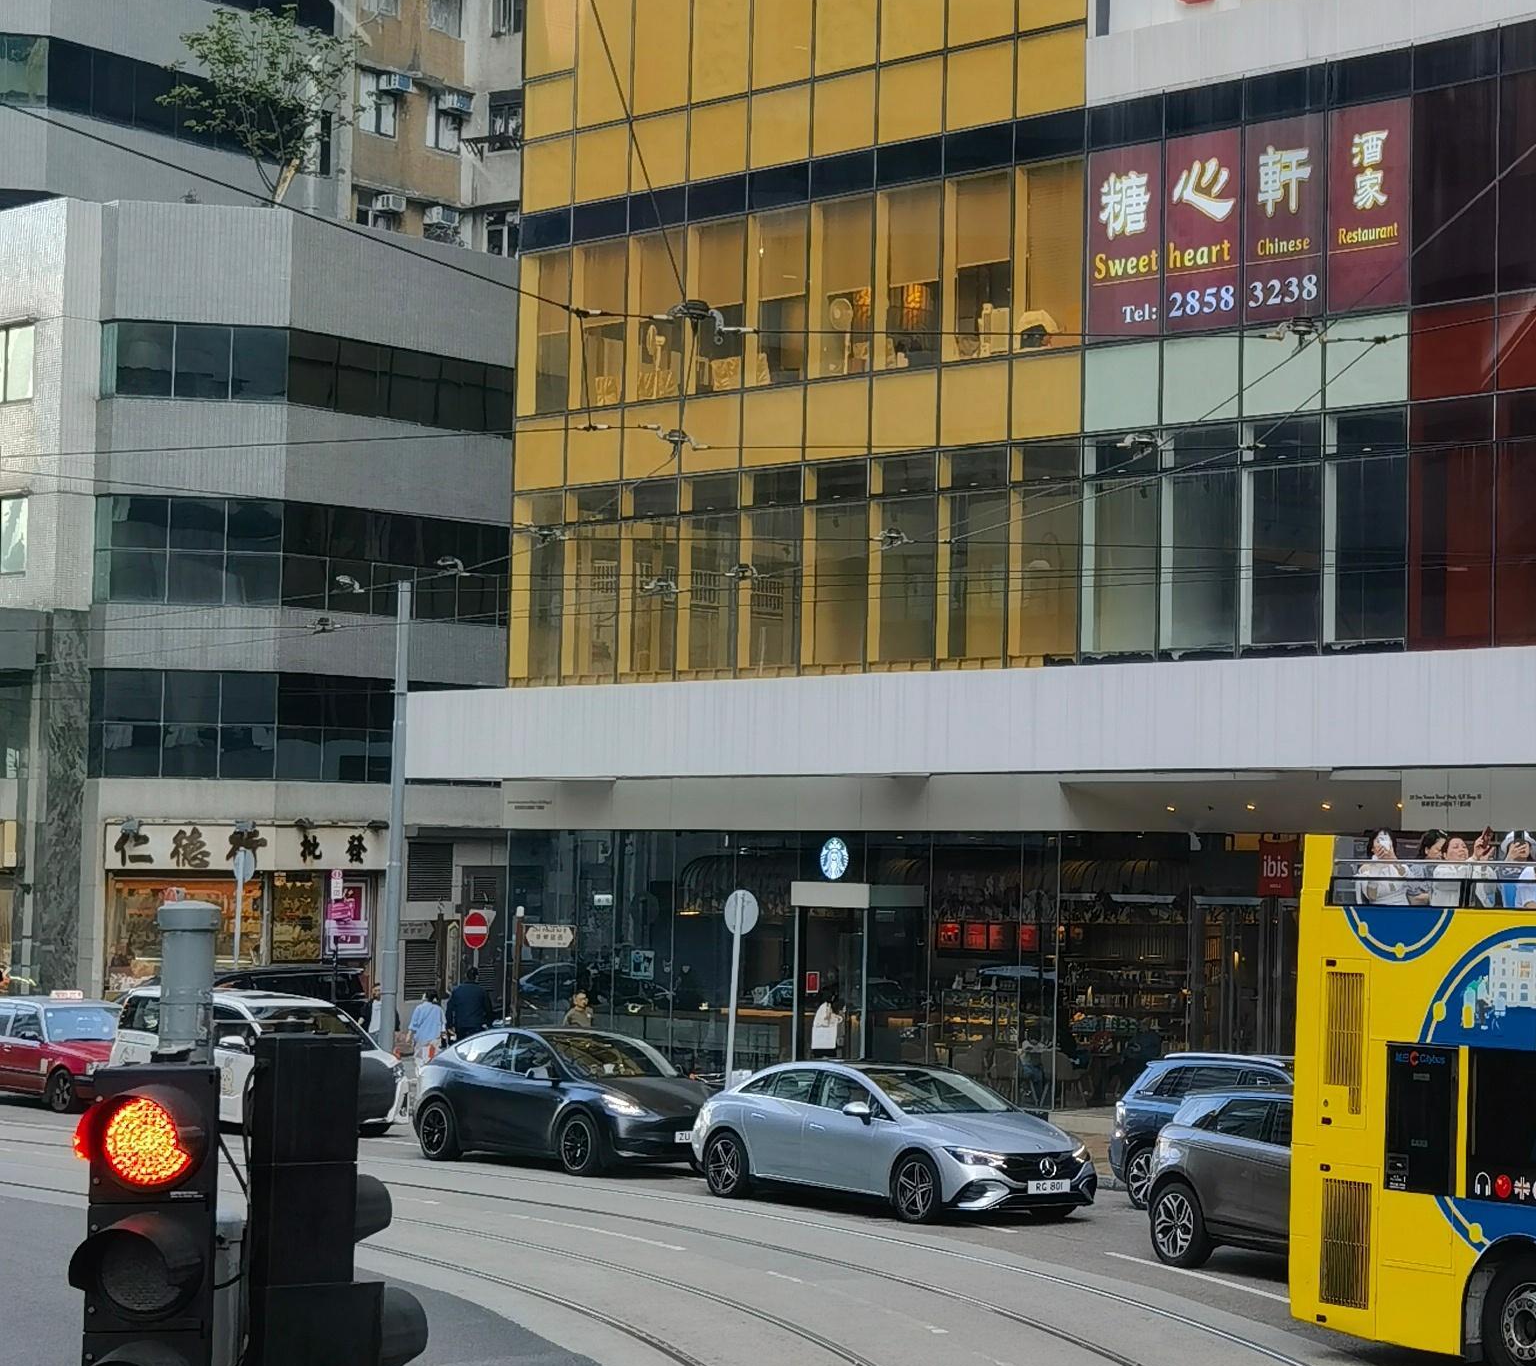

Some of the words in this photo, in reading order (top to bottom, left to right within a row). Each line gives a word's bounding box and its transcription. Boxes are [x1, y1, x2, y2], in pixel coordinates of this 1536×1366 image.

[1099, 145, 1312, 240] 糖心軒
[1351, 129, 1389, 210] 酒家
[1094, 249, 1159, 280] Sweet
[1168, 239, 1231, 269] heart
[1257, 237, 1311, 256] Chinese
[1337, 222, 1399, 245] Restaurant
[1122, 304, 1157, 324] Tel:
[1168, 285, 1235, 319] 2858
[1248, 274, 1318, 308] 3238
[1263, 855, 1289, 877] ibis
